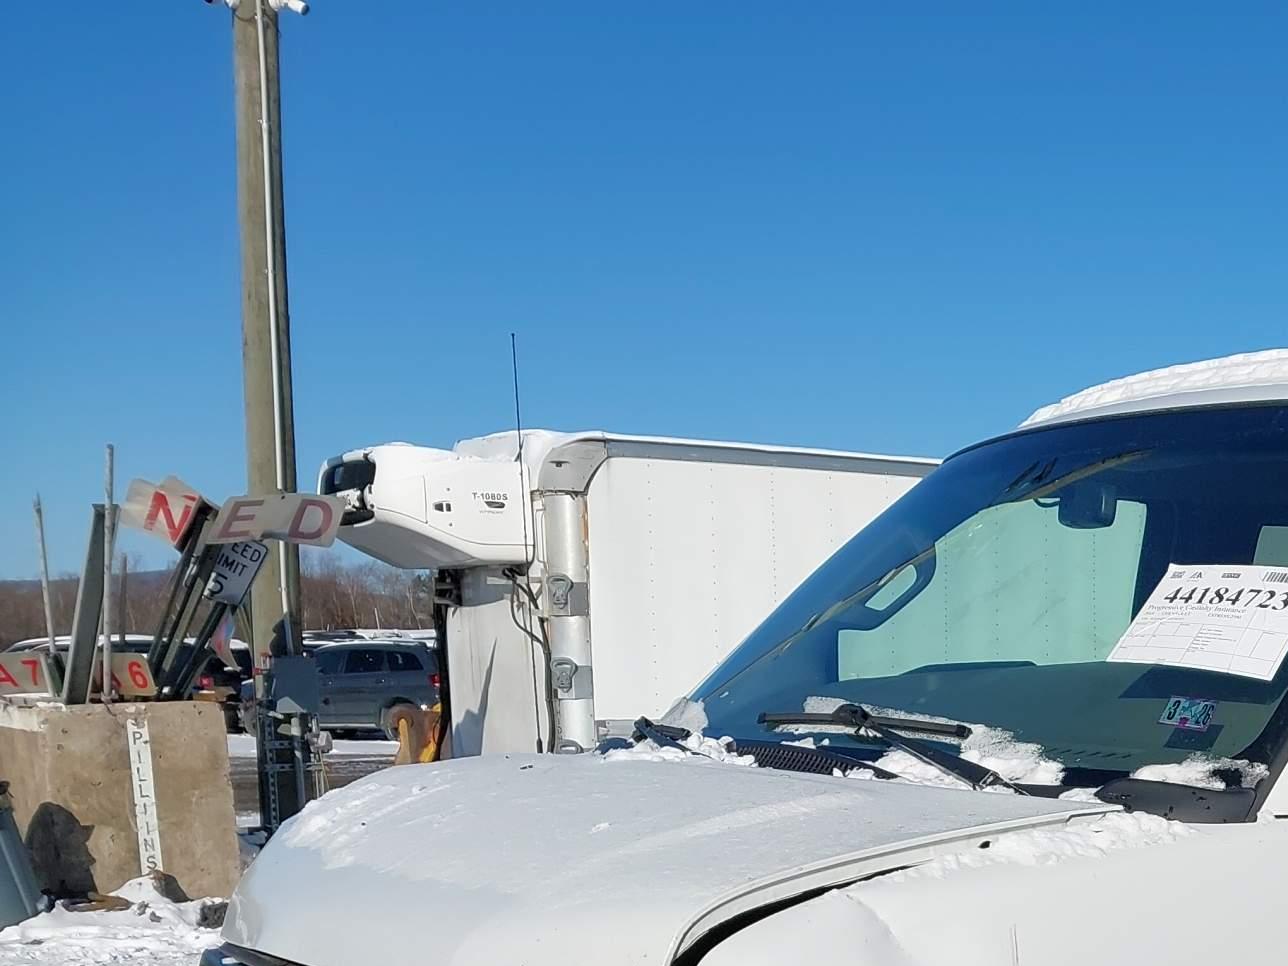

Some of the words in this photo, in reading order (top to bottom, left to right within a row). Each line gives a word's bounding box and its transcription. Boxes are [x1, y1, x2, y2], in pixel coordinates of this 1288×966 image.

[144, 490, 198, 544] N
[219, 499, 264, 539] E
[288, 498, 333, 541] D
[216, 553, 249, 577] IMIT
[1167, 700, 1181, 720] 3
